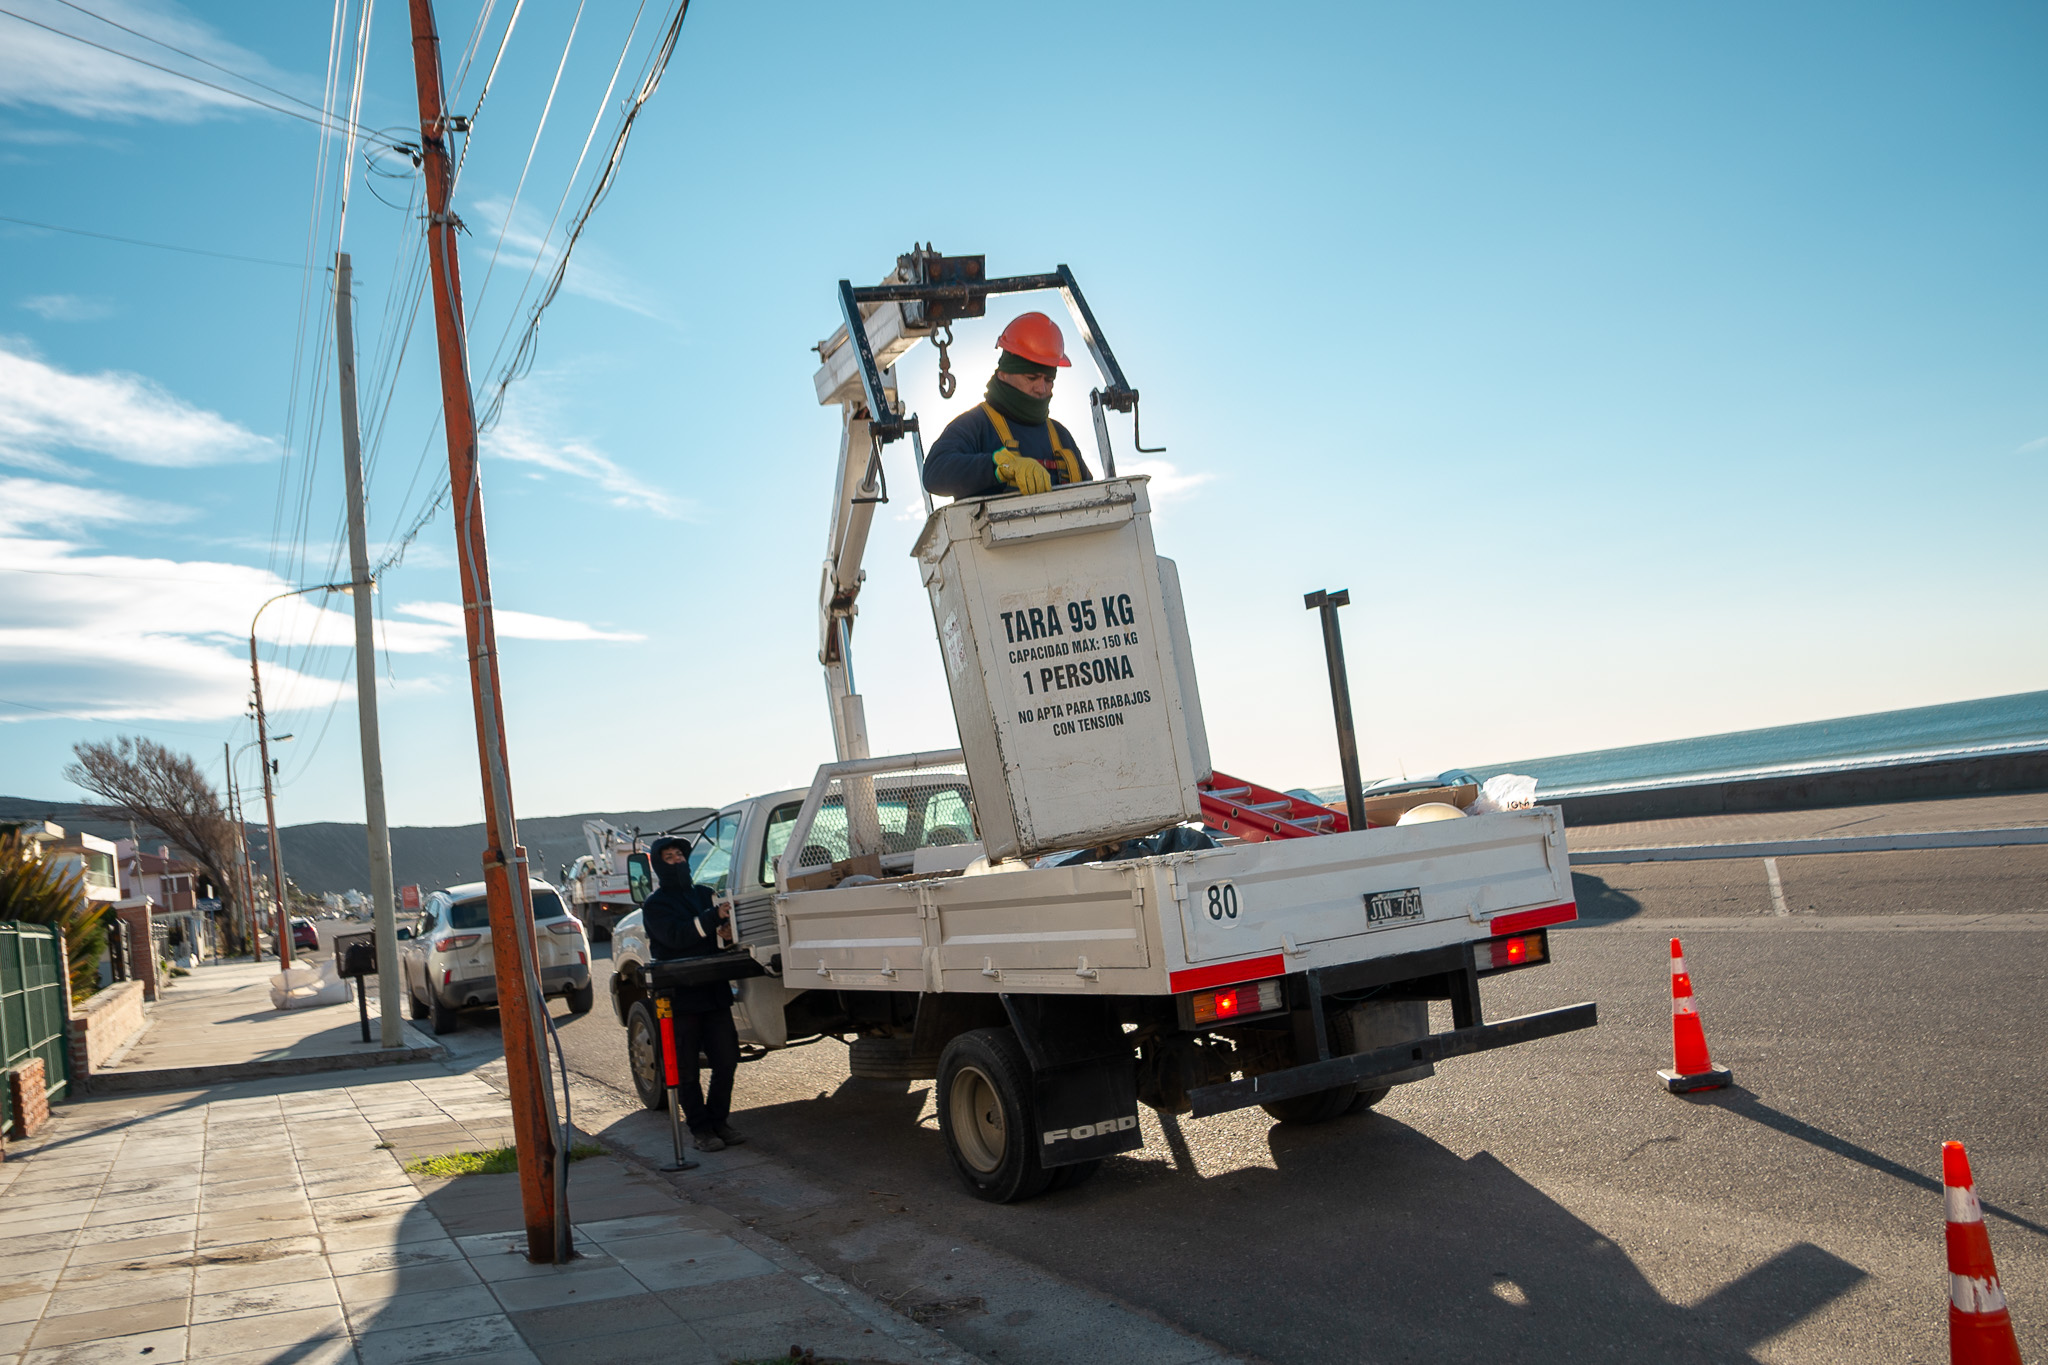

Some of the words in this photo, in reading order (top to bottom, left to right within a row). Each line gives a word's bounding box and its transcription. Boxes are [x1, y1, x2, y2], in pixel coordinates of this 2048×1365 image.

[1000, 605, 1064, 644] TARA
[1067, 601, 1097, 633] 95
[1101, 593, 1135, 628] KG
[1009, 642, 1070, 665] CAPACIDAD
[1072, 639, 1101, 655] MAX:
[1102, 634, 1122, 649] 150
[1123, 632, 1139, 646] KG
[1023, 671, 1034, 695] 1
[1040, 655, 1135, 693] PERSONA
[1018, 709, 1034, 724] NO
[1037, 704, 1064, 722] APTA
[1066, 699, 1095, 716] PARA
[1096, 690, 1152, 711] TRABAJOS
[1053, 720, 1076, 737] CON
[1078, 712, 1124, 732] TENSION
[1207, 884, 1238, 920] 80
[1370, 899, 1393, 920] JIN
[1397, 896, 1421, 916] 764
[1043, 1115, 1137, 1145] FORD
